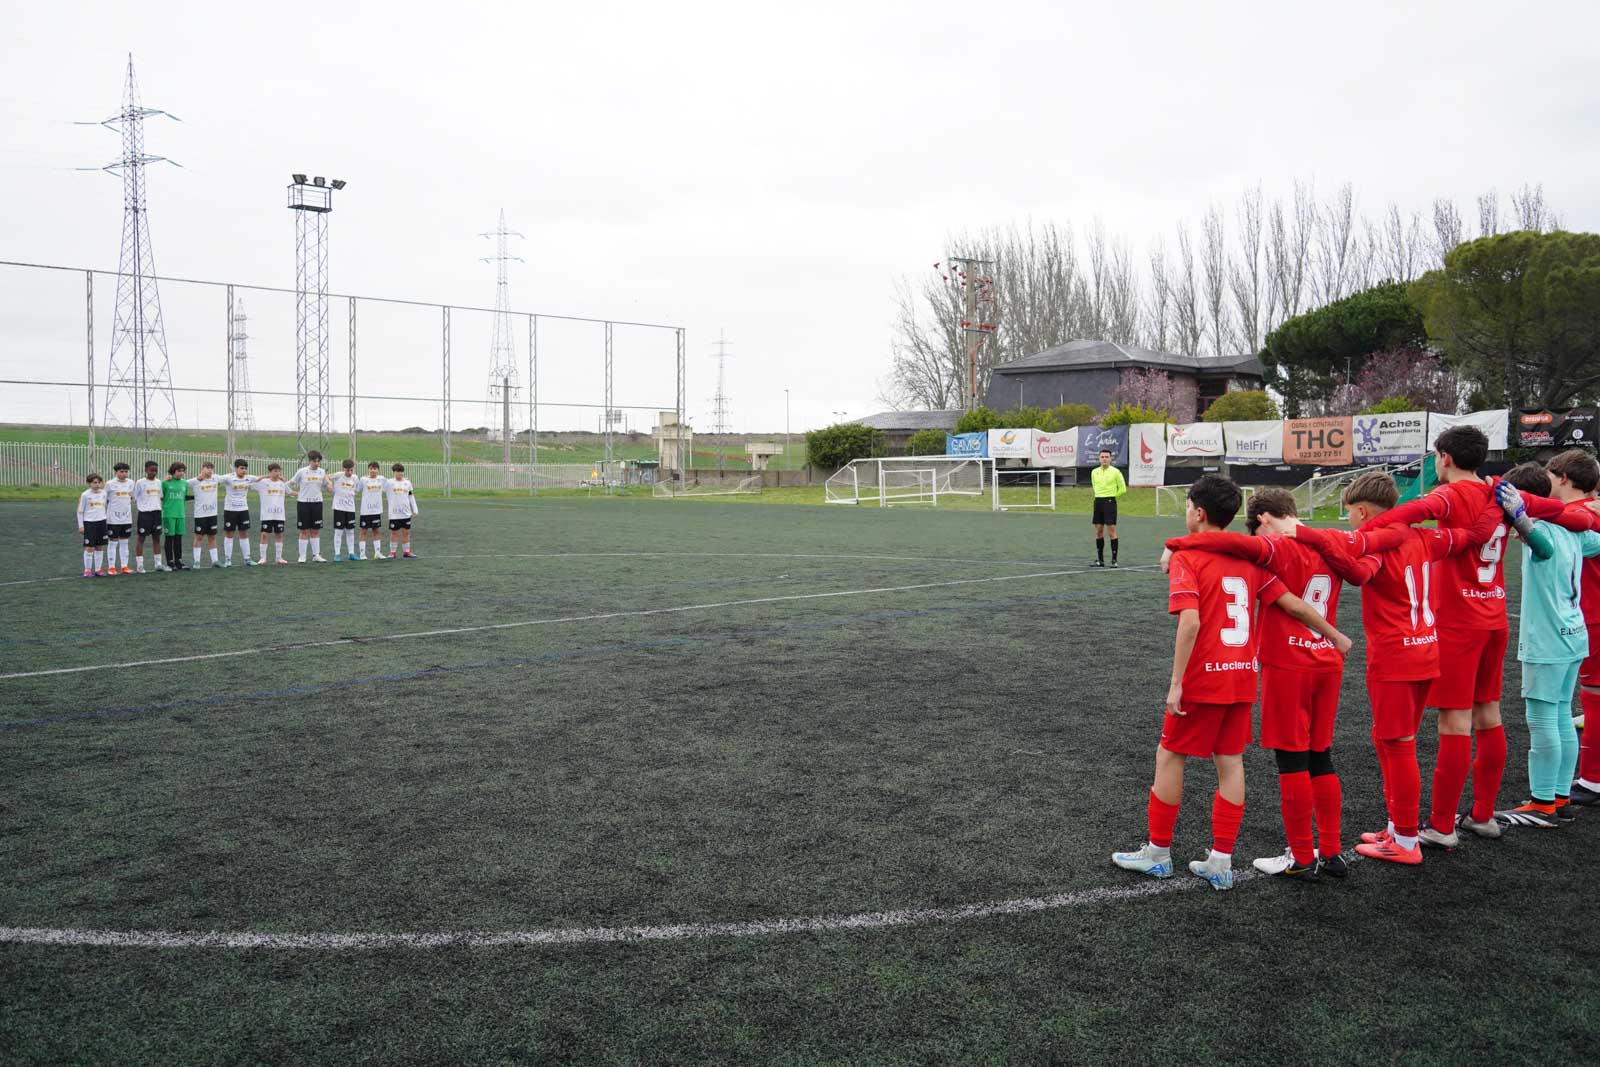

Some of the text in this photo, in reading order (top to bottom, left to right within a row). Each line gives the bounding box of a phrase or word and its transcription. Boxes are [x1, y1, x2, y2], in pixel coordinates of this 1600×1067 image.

[1291, 428, 1345, 450] THC
[1380, 419, 1421, 429] Aches
[1236, 440, 1267, 451] HelFri
[1478, 523, 1506, 583] 9
[1221, 576, 1249, 647] 3
[1302, 574, 1331, 640] 8
[1405, 561, 1434, 630] 11
[1205, 661, 1251, 672] E.Leclerc
